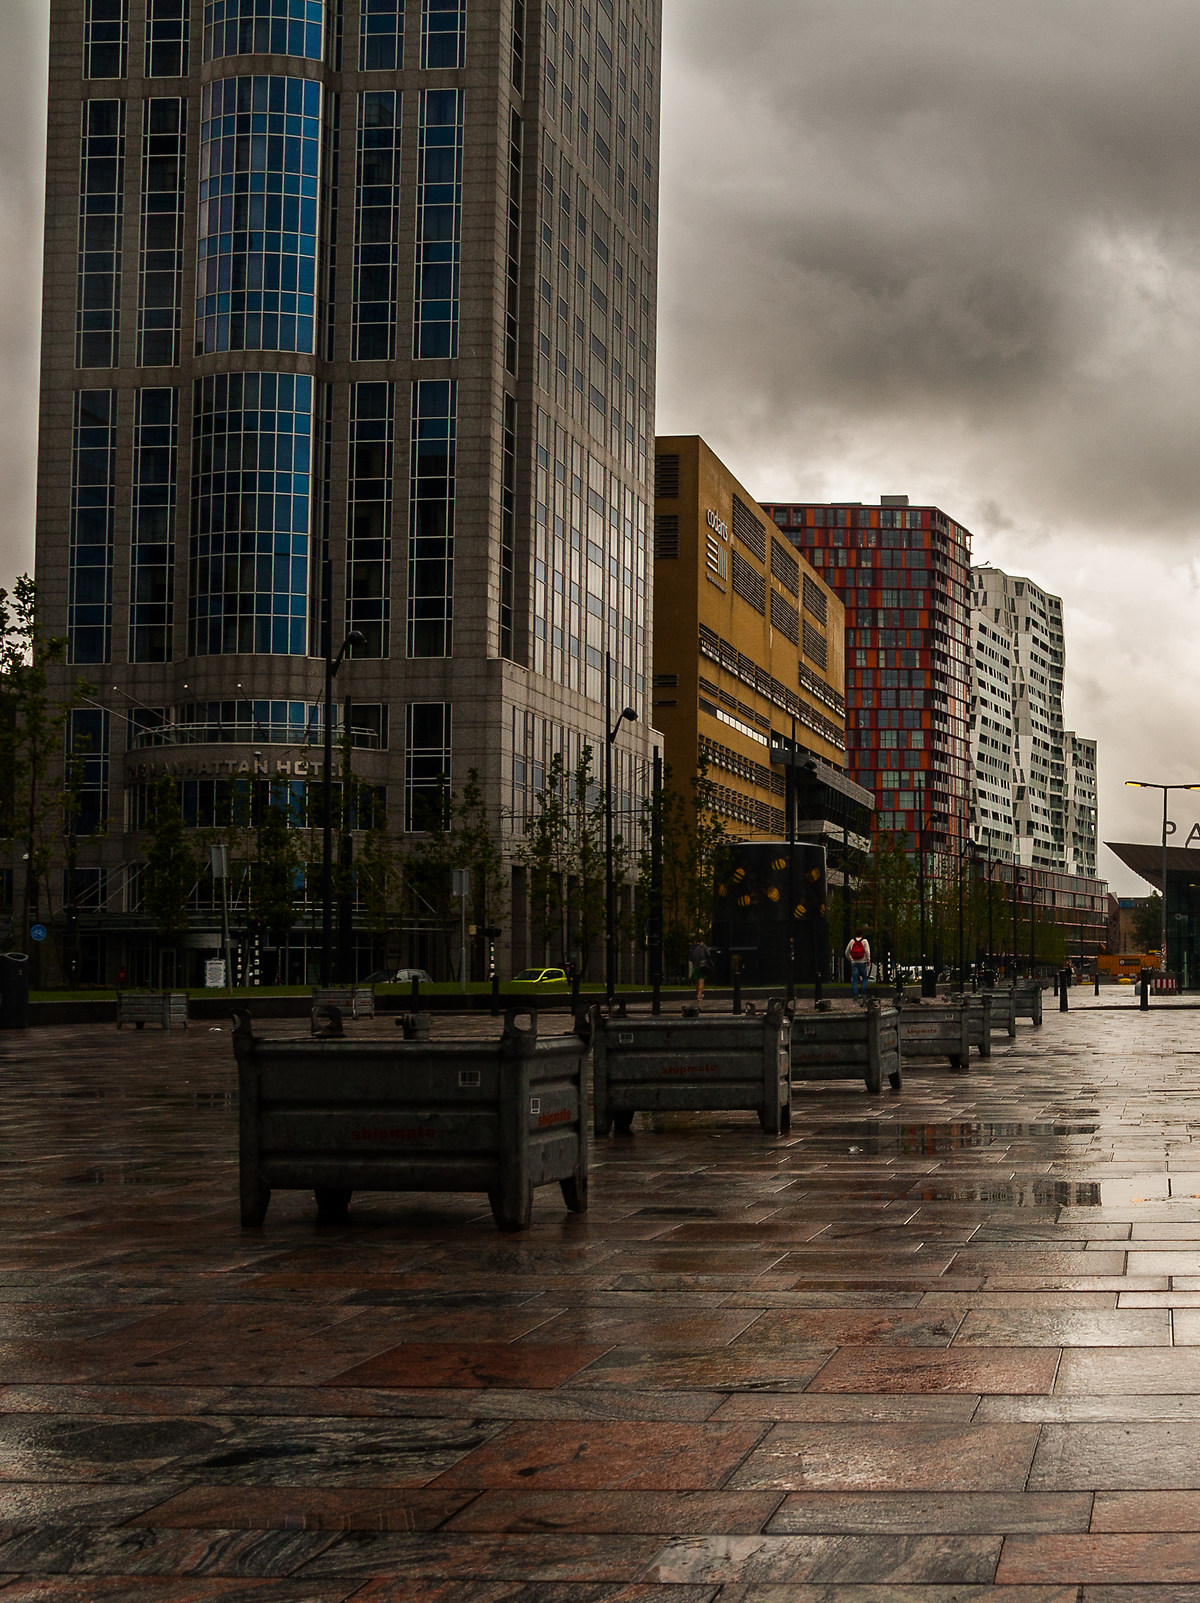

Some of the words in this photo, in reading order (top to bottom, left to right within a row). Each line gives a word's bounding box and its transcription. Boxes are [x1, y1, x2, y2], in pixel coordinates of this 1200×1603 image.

[661, 1063, 718, 1075] shipmate
[538, 1107, 572, 1128] shipmate
[351, 1126, 436, 1142] shipmate
